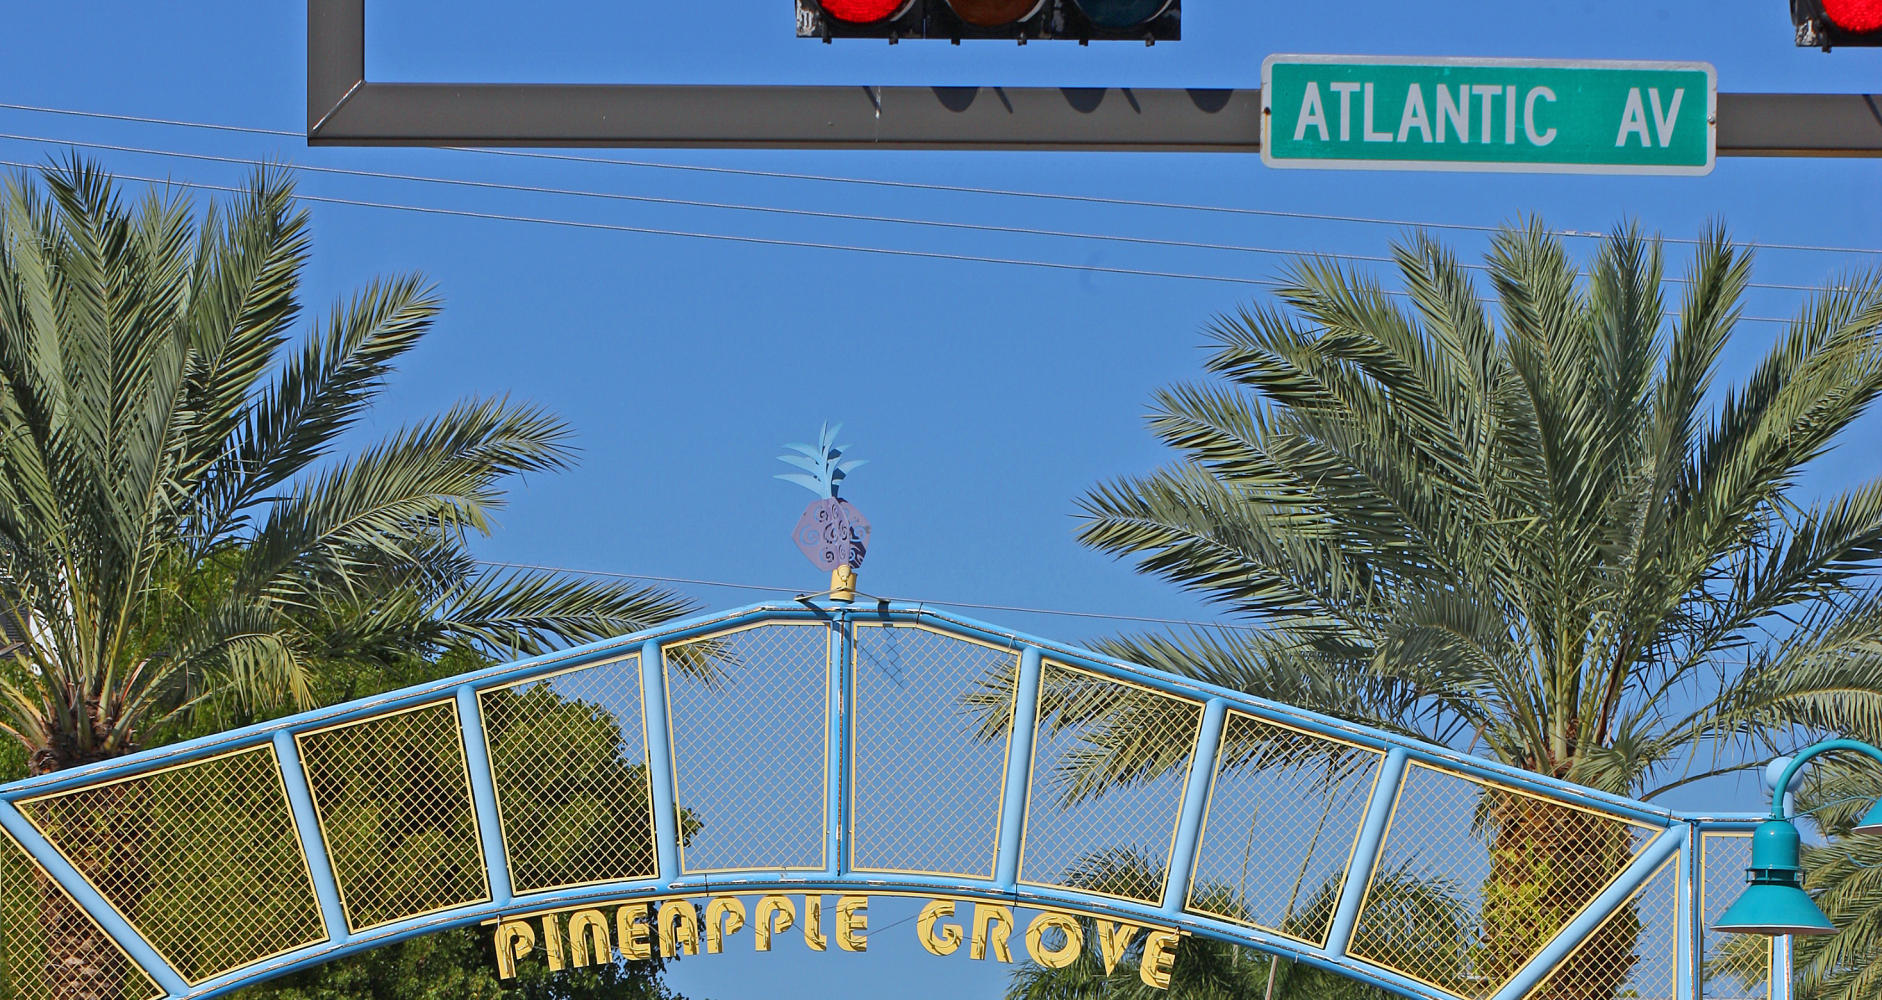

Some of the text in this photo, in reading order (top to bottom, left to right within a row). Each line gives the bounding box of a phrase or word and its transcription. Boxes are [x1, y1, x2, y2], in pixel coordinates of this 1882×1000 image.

[1293, 81, 1685, 148] ATLANTIC AV
[494, 893, 1182, 991] PINEAPPLE GROVE
